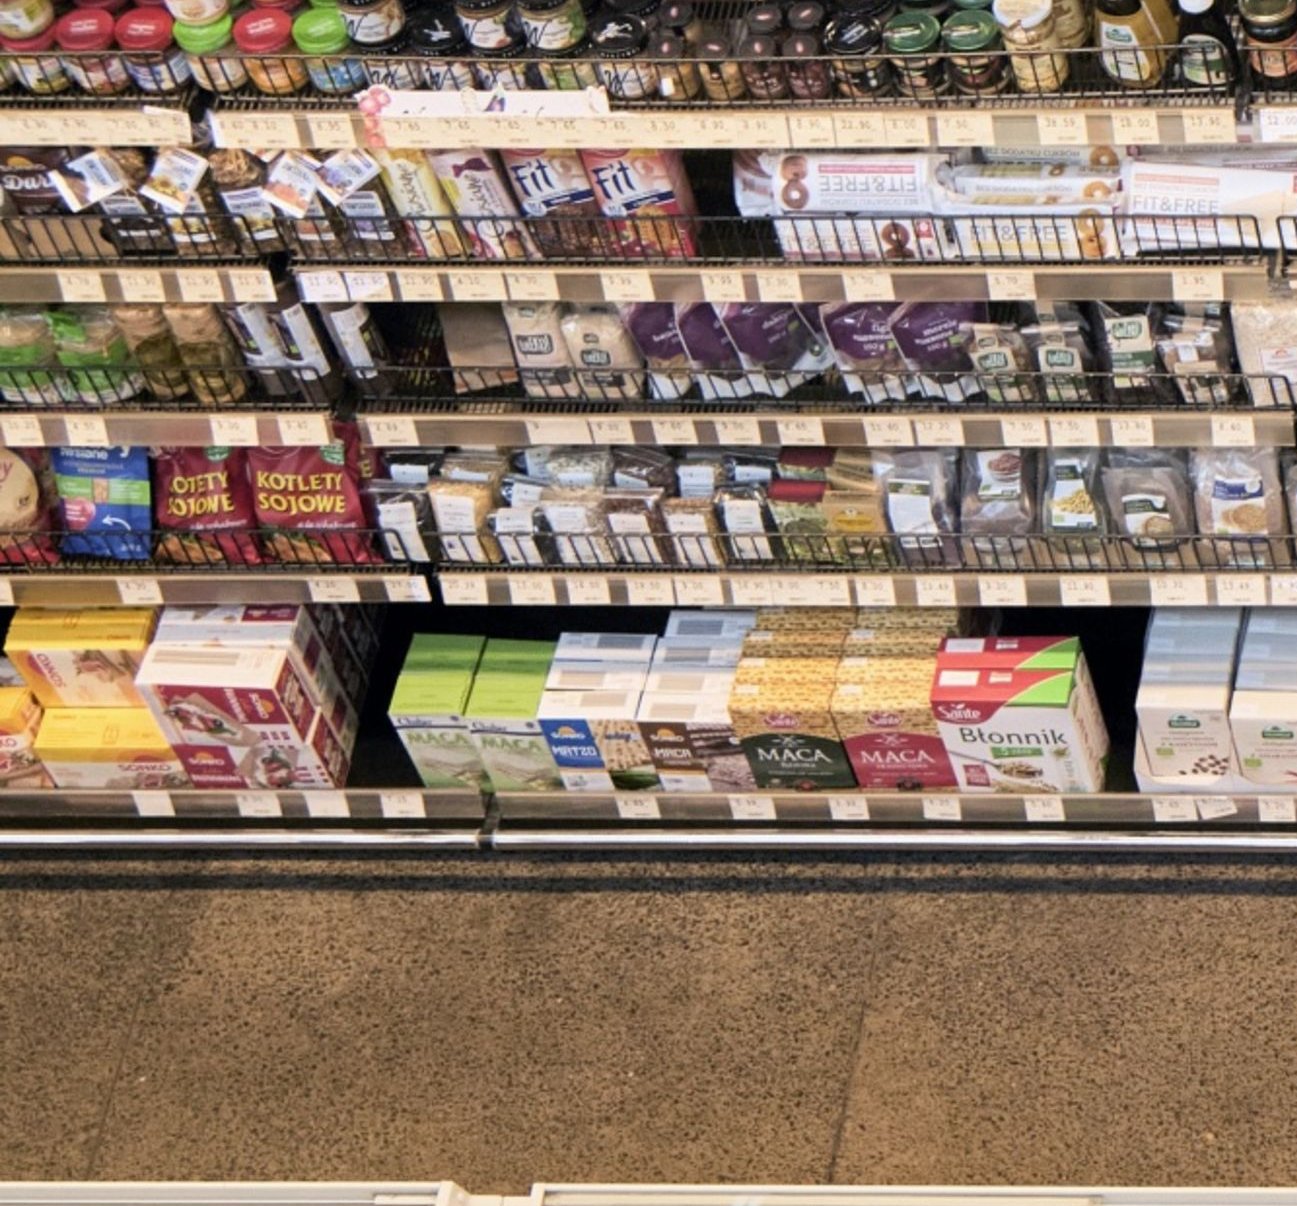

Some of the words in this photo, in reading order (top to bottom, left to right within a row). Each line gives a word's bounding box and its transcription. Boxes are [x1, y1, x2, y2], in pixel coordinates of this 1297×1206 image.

[510, 160, 555, 193] Fit
[593, 160, 635, 199] Fit
[818, 175, 918, 193] FIT&FREE
[1132, 194, 1219, 214] FIT&FREE
[256, 473, 343, 491] KOTLETY
[258, 494, 347, 515] SOJOWE
[937, 703, 982, 722] Sante
[406, 732, 470, 747] MACA
[481, 735, 542, 752] MACA
[960, 726, 1068, 747] Błonnik
[552, 746, 597, 757] MATZO
[654, 748, 693, 760] MACA
[756, 747, 831, 765] MACA
[861, 748, 932, 765] MACA
